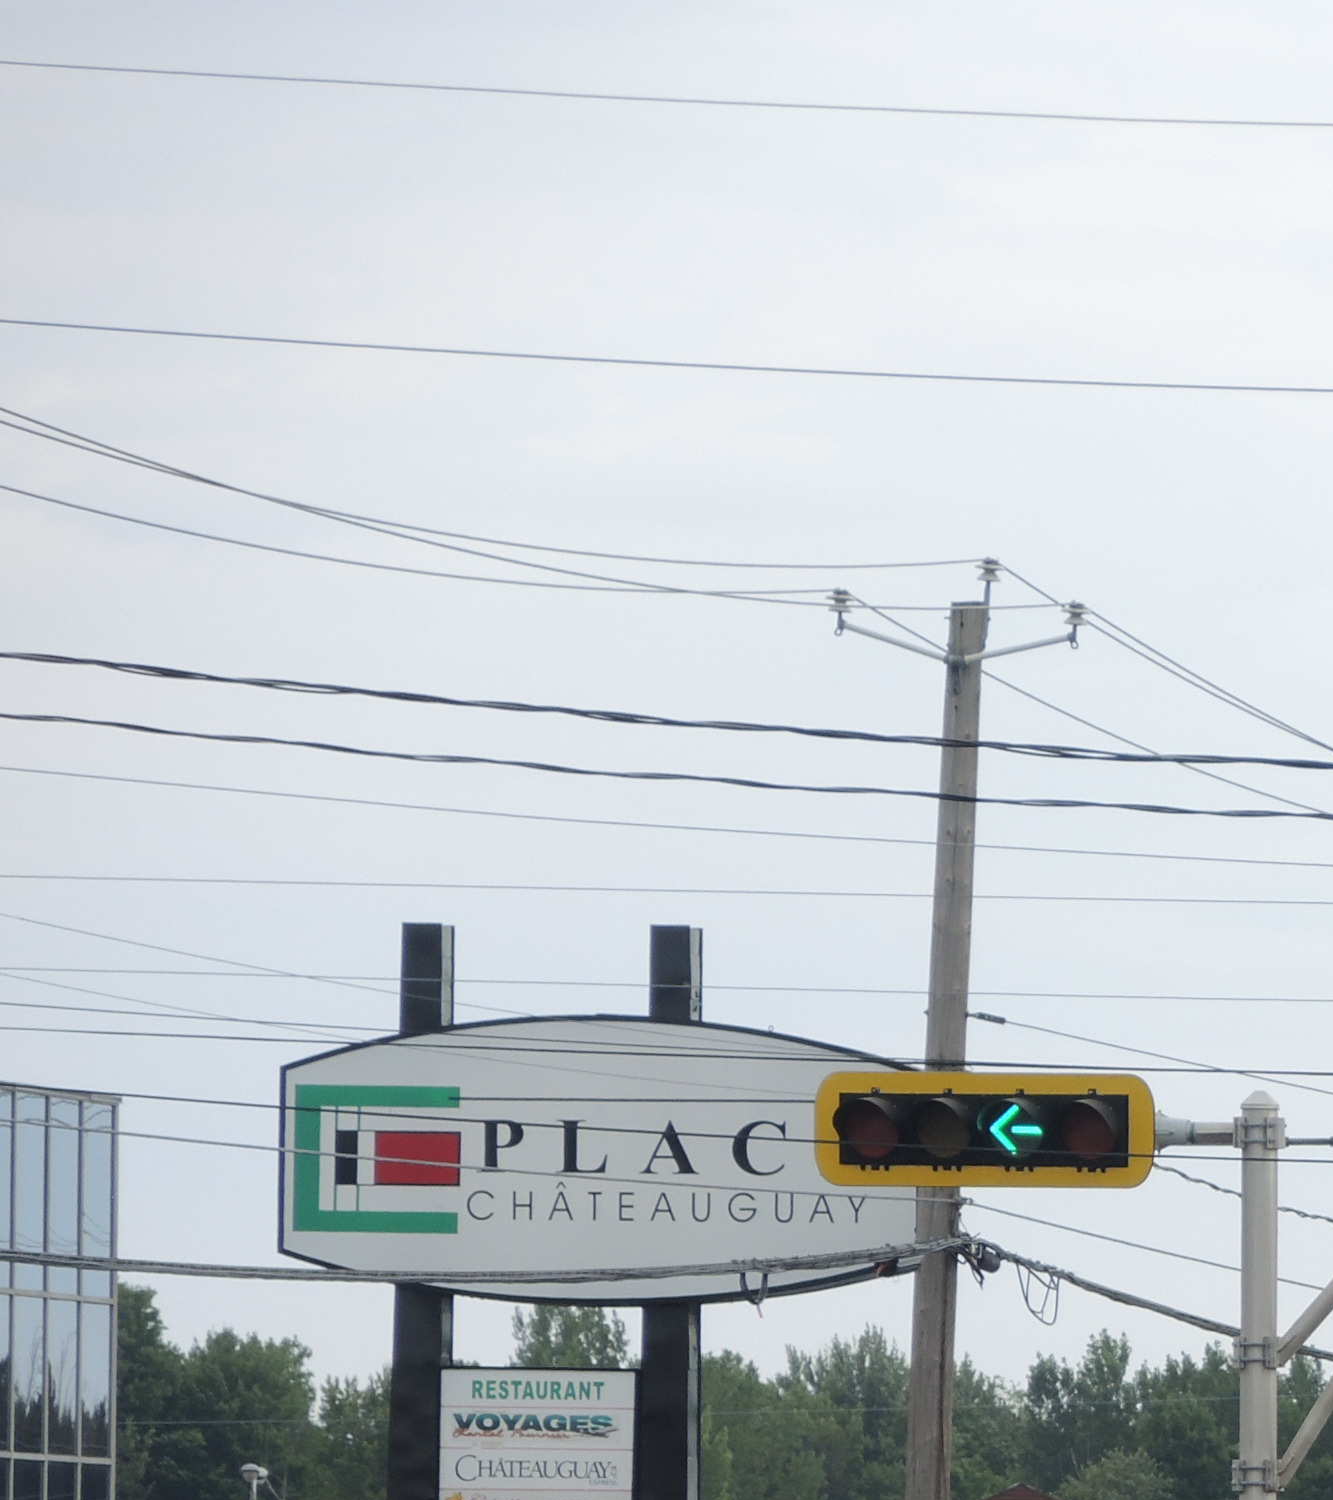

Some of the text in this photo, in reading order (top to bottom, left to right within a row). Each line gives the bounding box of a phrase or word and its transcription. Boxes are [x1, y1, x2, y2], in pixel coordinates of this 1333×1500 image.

[466, 1181, 868, 1225] CHÂTEAUGUAY
[471, 1379, 605, 1401] RESTAURANT
[452, 1413, 613, 1432] VOYAGES
[454, 1454, 613, 1482] CHÂTEAUGUAY
